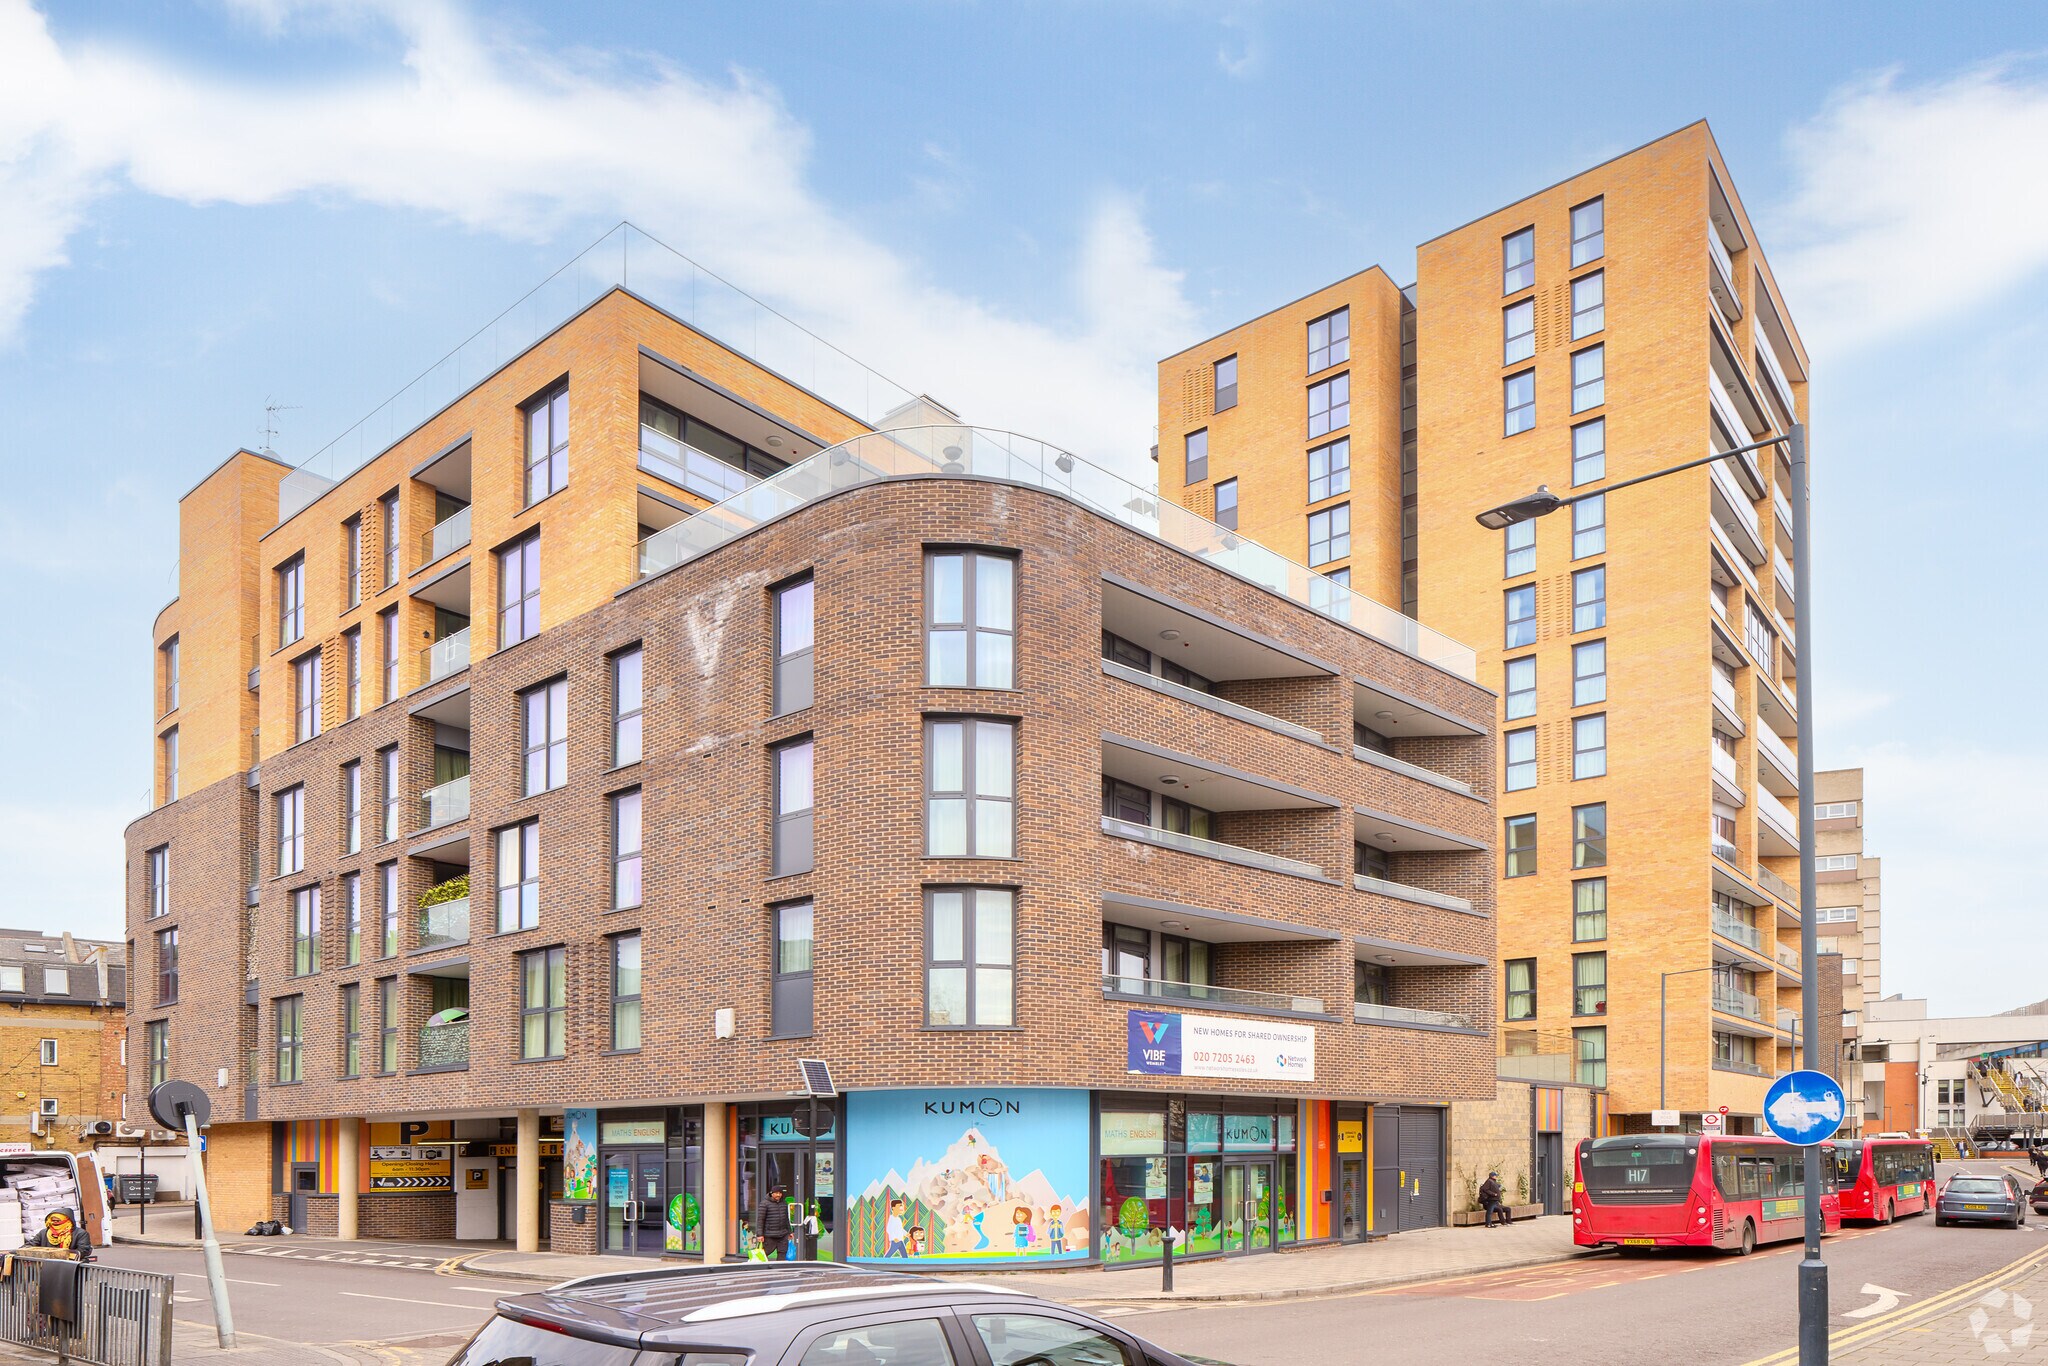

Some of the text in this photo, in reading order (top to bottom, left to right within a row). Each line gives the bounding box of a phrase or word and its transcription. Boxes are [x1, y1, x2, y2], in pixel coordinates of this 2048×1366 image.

[1193, 1027, 1307, 1042] NEW HOMES FOR SHARED OWNERSHIP
[1142, 1048, 1165, 1061] VIBE
[1193, 1051, 1255, 1065] 020 7205 2463
[924, 1098, 1019, 1117] KUMON
[400, 1121, 429, 1145] P
[611, 1128, 660, 1137] MATHS ENGLISH
[1104, 1130, 1157, 1138] MATHS ENGLISH
[1226, 1126, 1268, 1141] KUMON
[473, 1172, 481, 1180] P
[1628, 1169, 1647, 1182] H17
